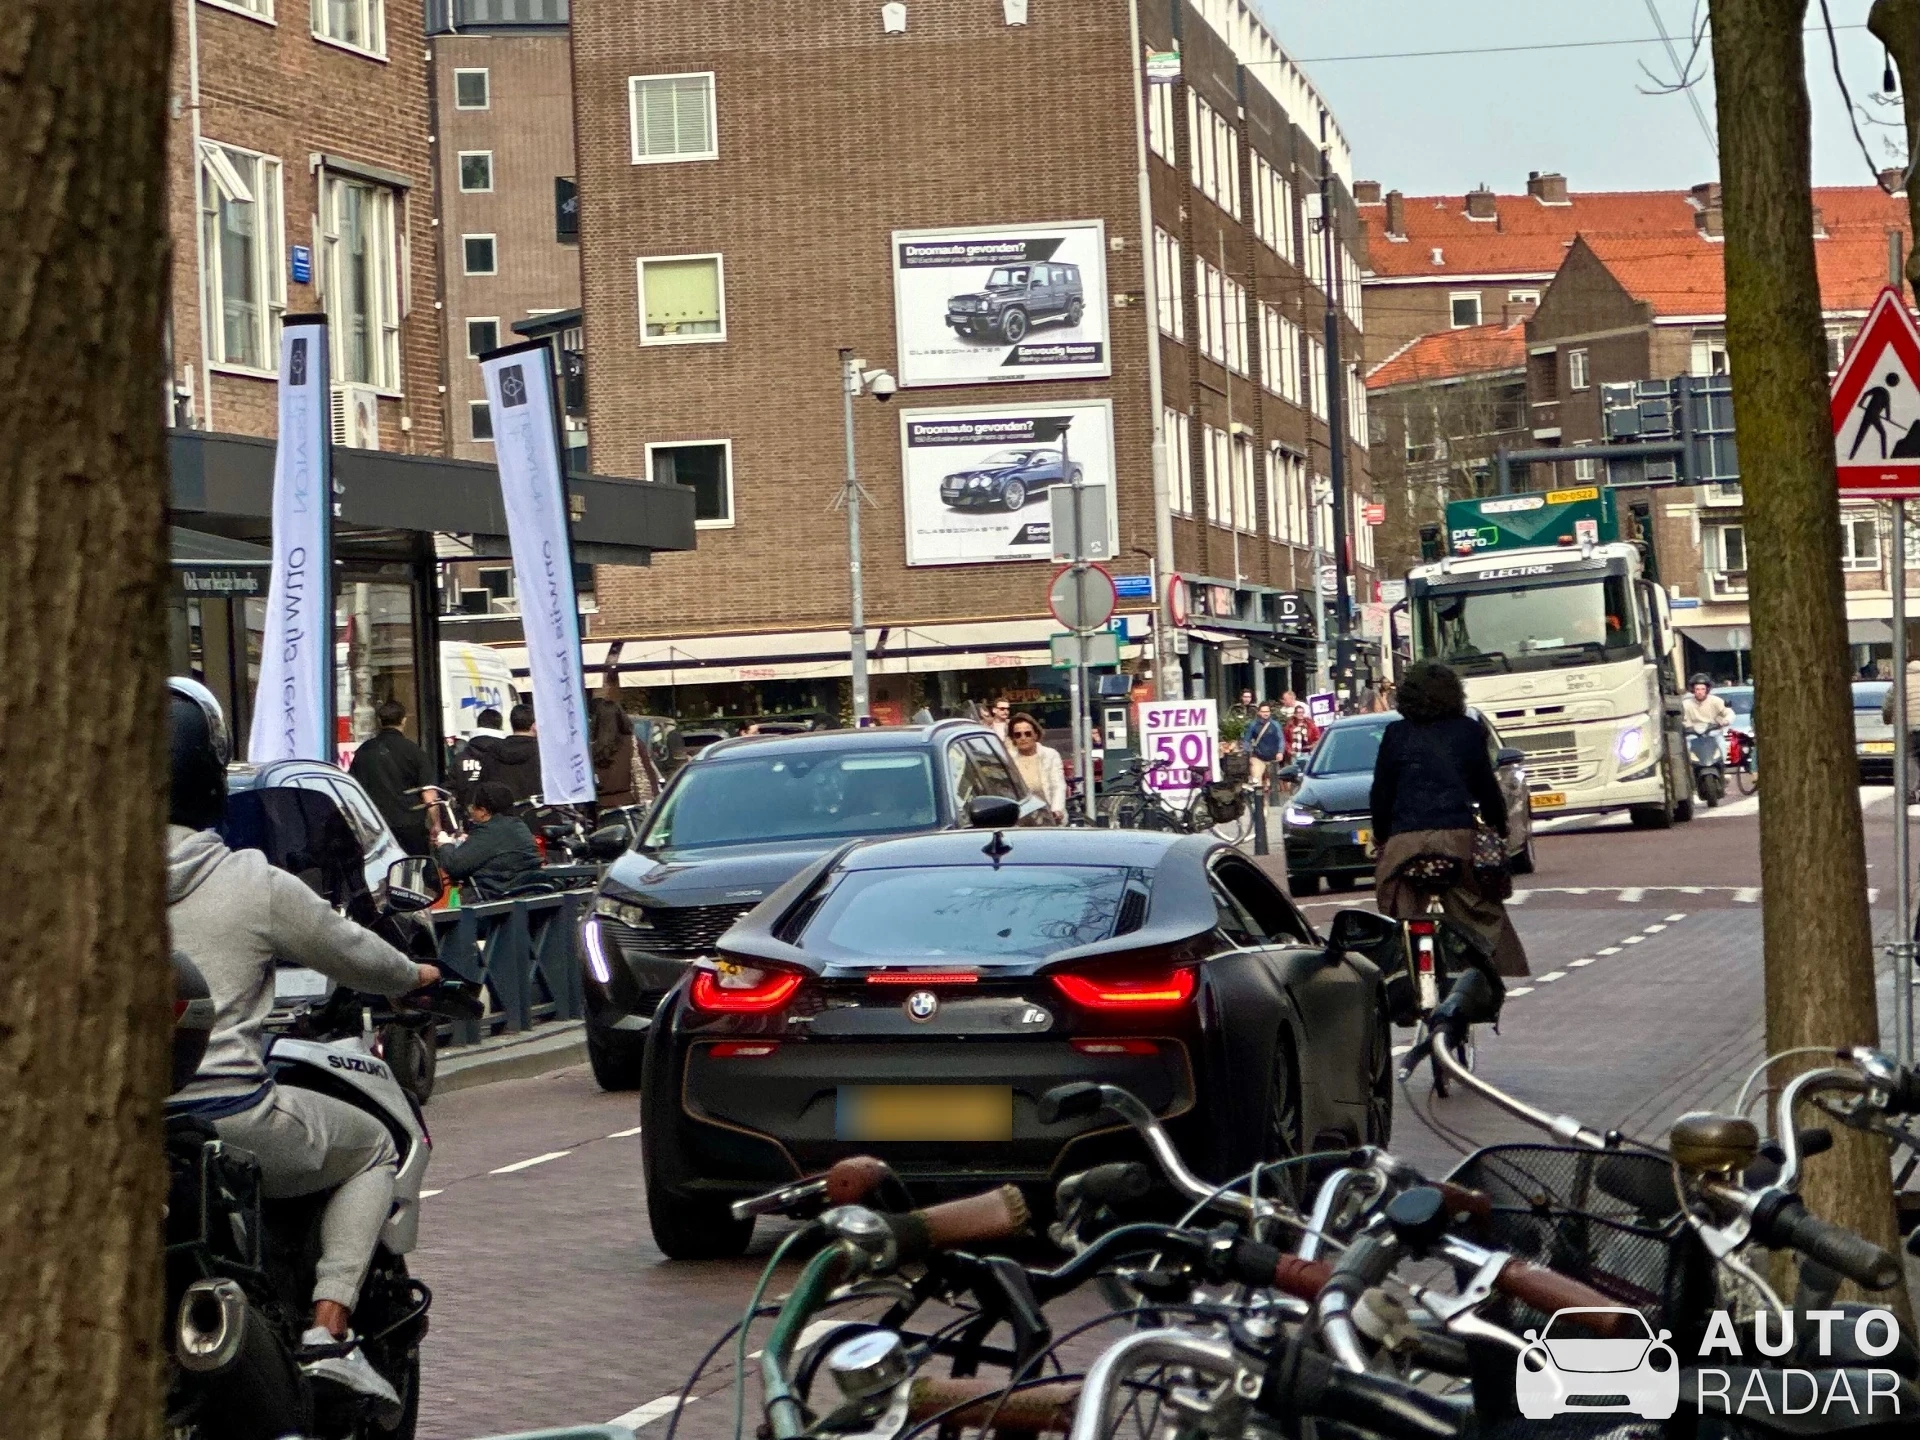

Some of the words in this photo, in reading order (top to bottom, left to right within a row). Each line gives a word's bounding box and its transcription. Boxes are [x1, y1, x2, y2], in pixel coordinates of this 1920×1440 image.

[906, 245, 965, 256] Droomauto
[966, 242, 1026, 256] gevonden?
[914, 423, 973, 435] Droomauto
[974, 421, 1034, 435] gevonden?
[1452, 527, 1477, 540] pre
[1453, 537, 1487, 548] zero
[1479, 564, 1554, 580] ELECTRIC
[1283, 601, 1297, 615] D
[1111, 618, 1122, 631] P
[1146, 708, 1207, 728] STEM
[1156, 734, 1203, 768] 50
[1156, 769, 1201, 785] PLU
[327, 1055, 389, 1080] SUZUKI
